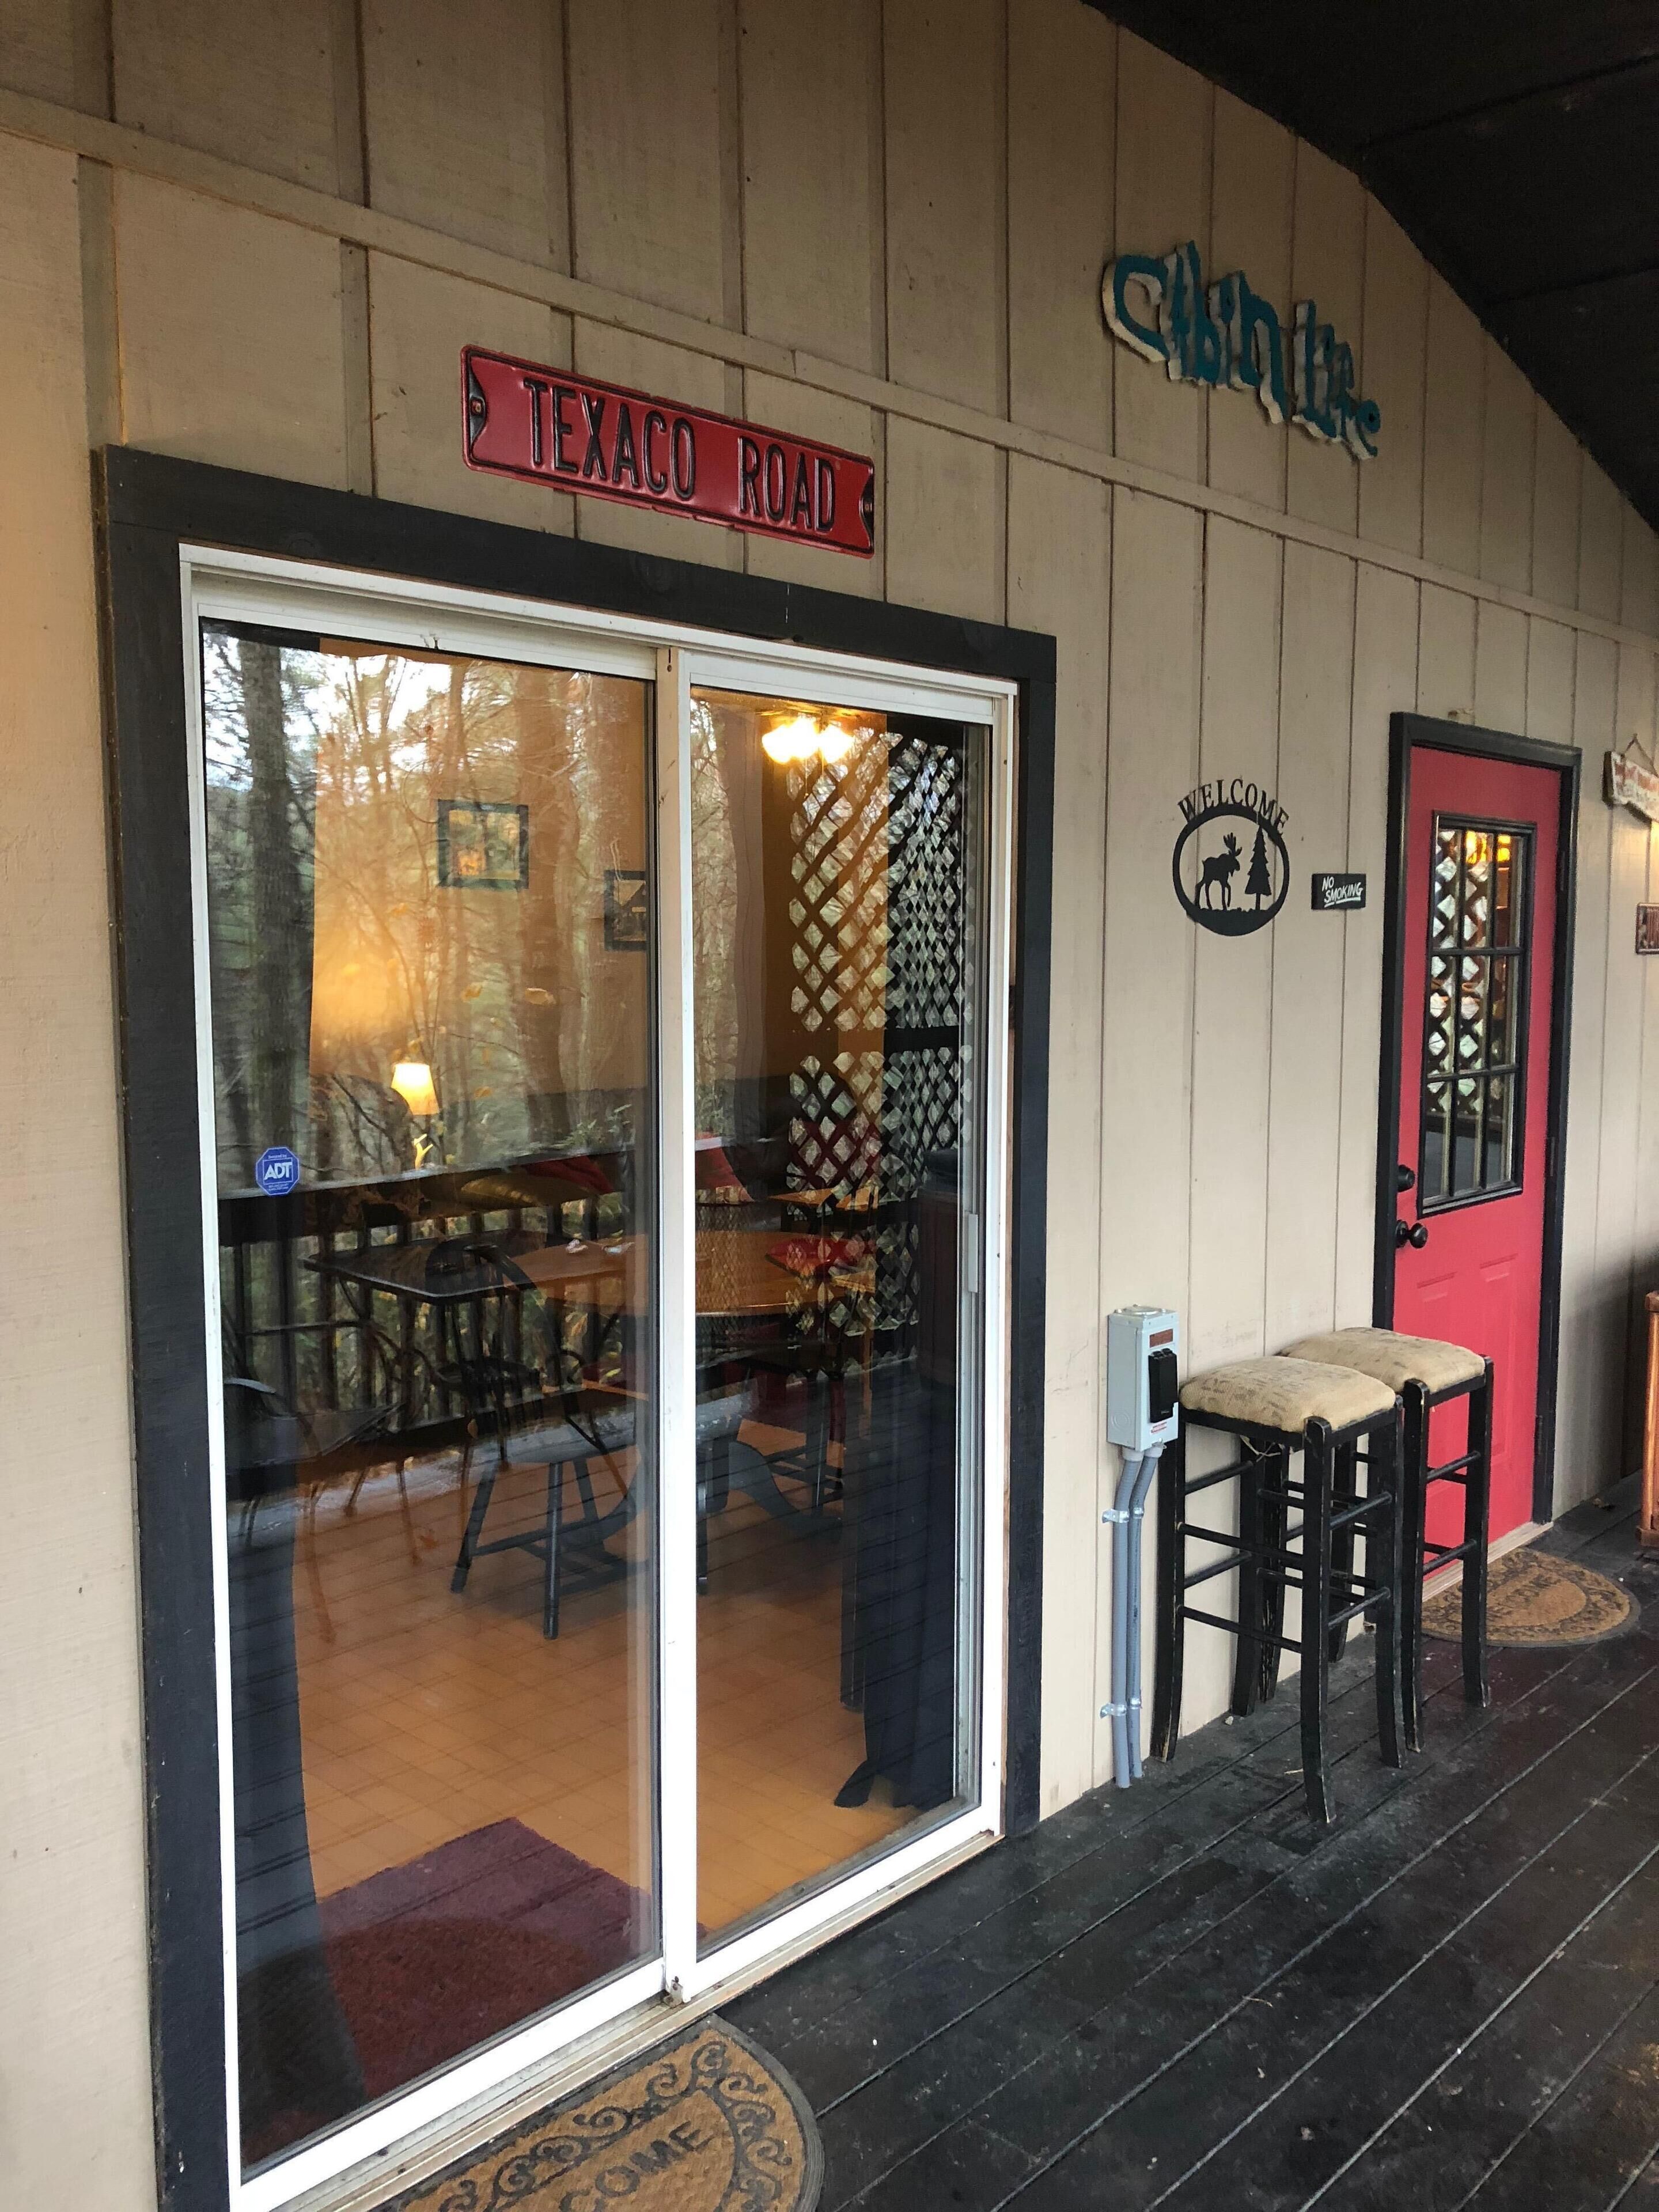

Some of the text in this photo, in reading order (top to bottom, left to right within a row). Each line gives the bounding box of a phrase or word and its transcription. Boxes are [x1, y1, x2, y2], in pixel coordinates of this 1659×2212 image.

[523, 377, 836, 532] TEXACO ROAD
[1177, 778, 1289, 835] WELCOME
[1322, 876, 1334, 892] NO
[1324, 882, 1363, 903] SMOKING
[263, 1161, 293, 1180] ADT
